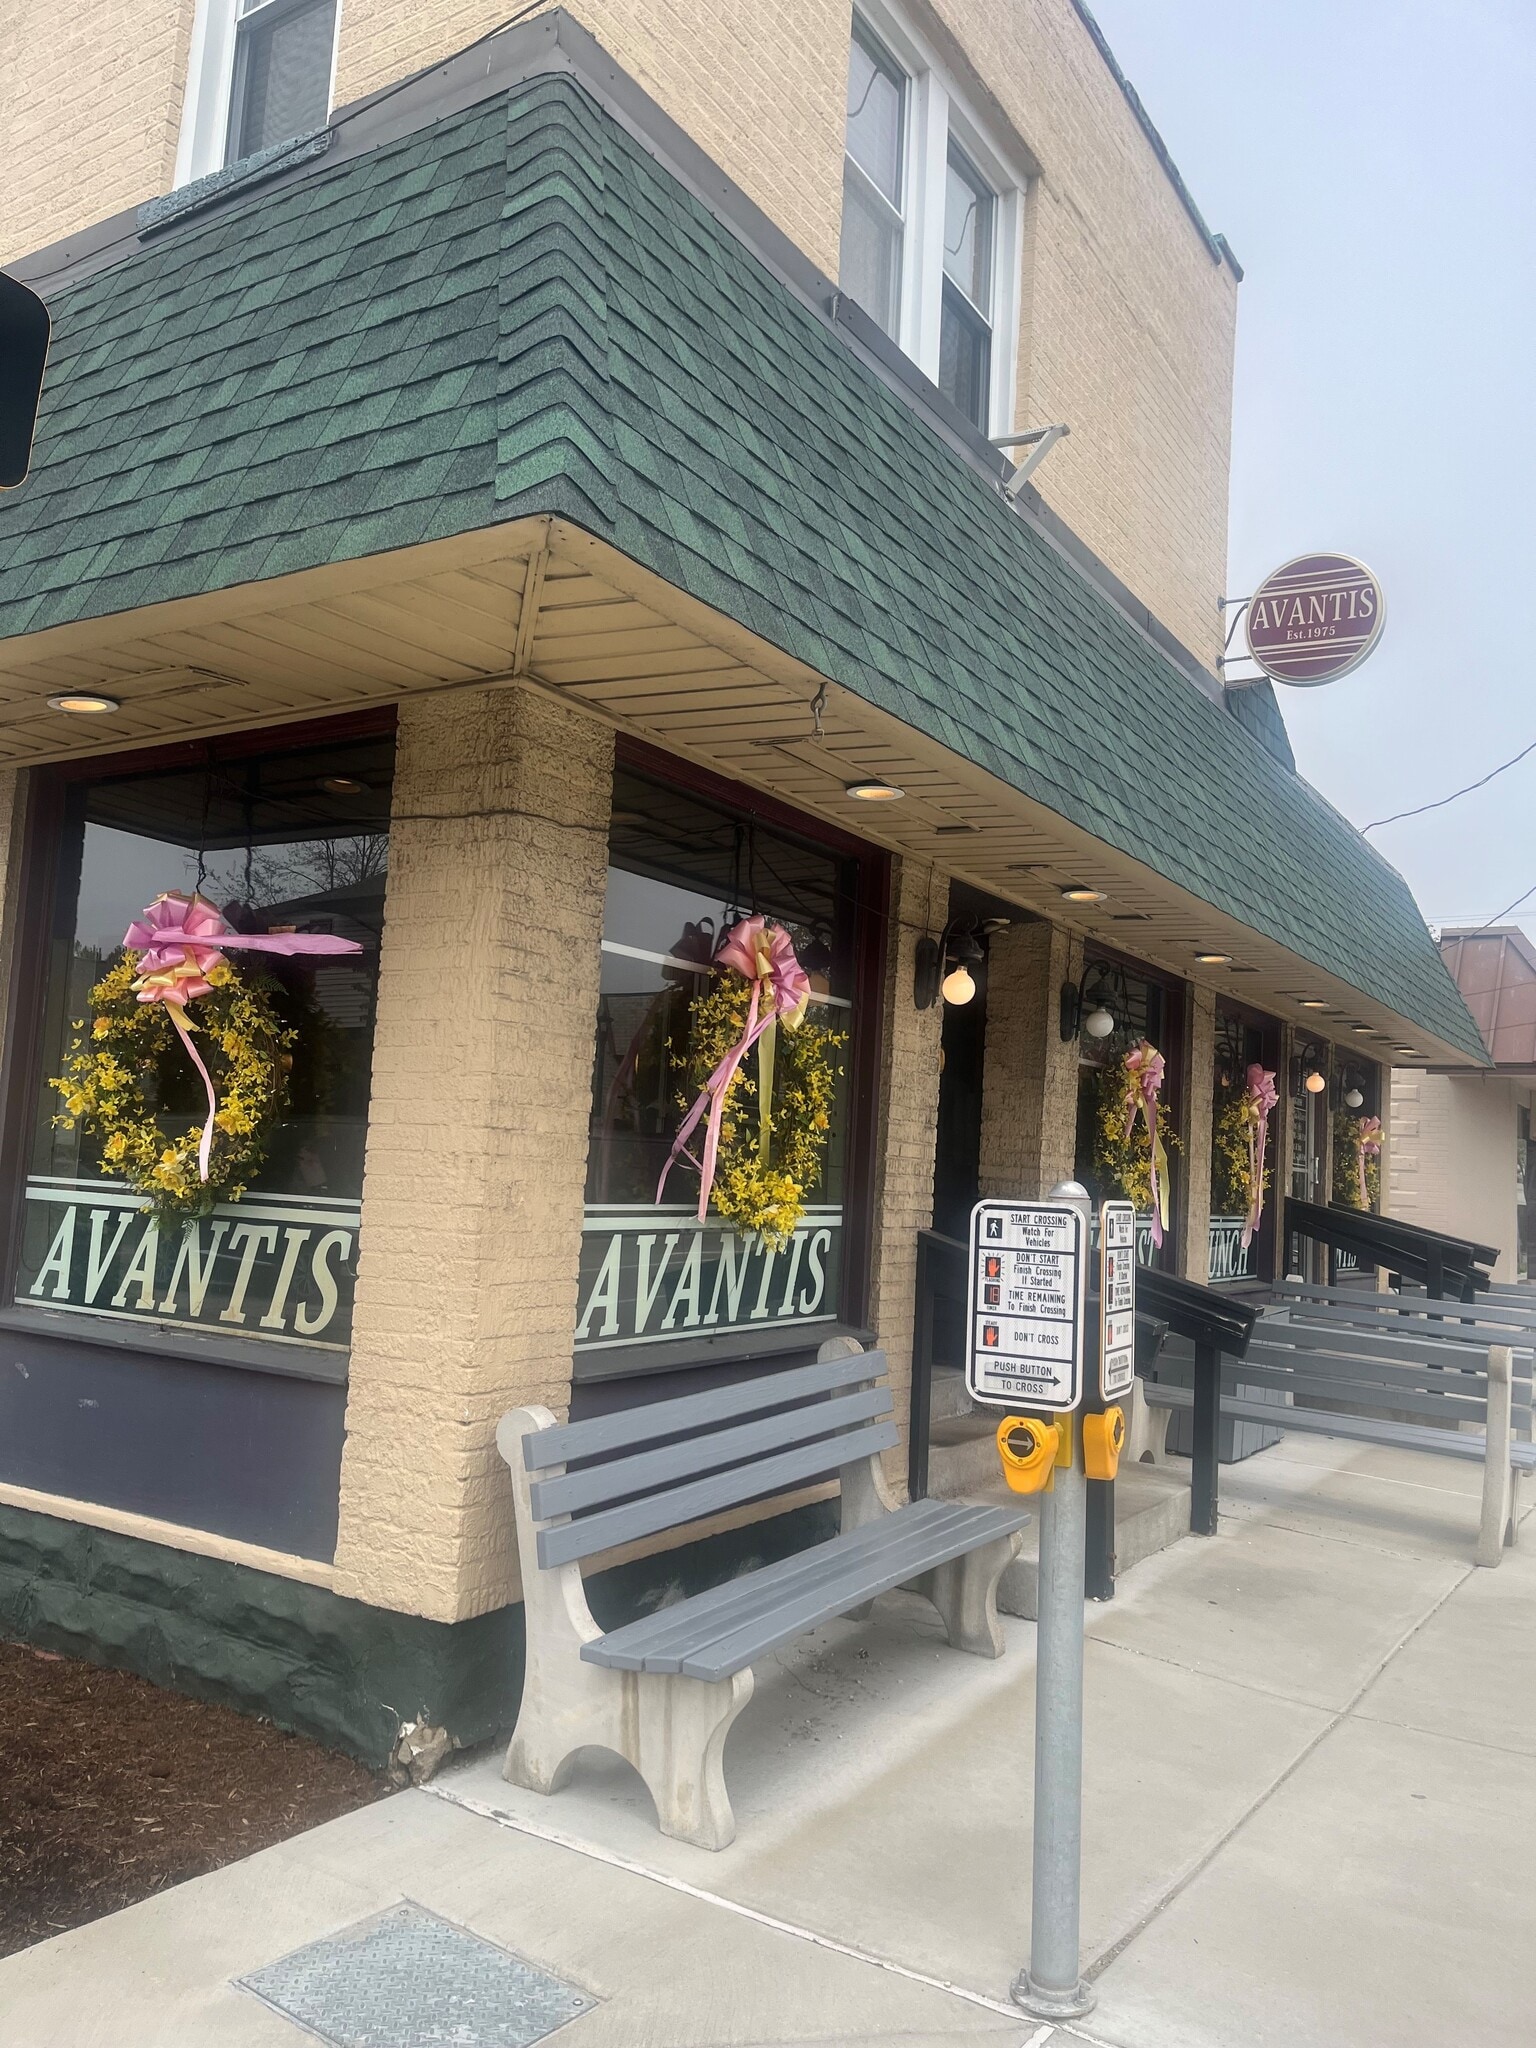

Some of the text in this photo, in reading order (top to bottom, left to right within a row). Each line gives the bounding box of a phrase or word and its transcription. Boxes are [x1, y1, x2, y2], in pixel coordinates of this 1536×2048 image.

[1252, 587, 1374, 630] AVANTIS
[1010, 1213, 1067, 1226] START CROSSING
[1022, 1226, 1054, 1237] Watch For
[1025, 1237, 1051, 1247] Vehicles
[1016, 1253, 1059, 1265] DON'T START
[1208, 1229, 1248, 1278] UNCH
[29, 1205, 353, 1335] AVANTIS
[1014, 1264, 1062, 1279] Finish Crossing
[574, 1228, 832, 1340] AVANTIS
[1030, 1276, 1053, 1287] Started
[1009, 1290, 1066, 1304] TIME REMAINING
[1008, 1301, 1066, 1317] To Finish Crossing
[1014, 1331, 1059, 1345] DON'T CROSS
[994, 1361, 1052, 1377] PUSH BUTTON
[1001, 1379, 1044, 1394] TO CROSS
